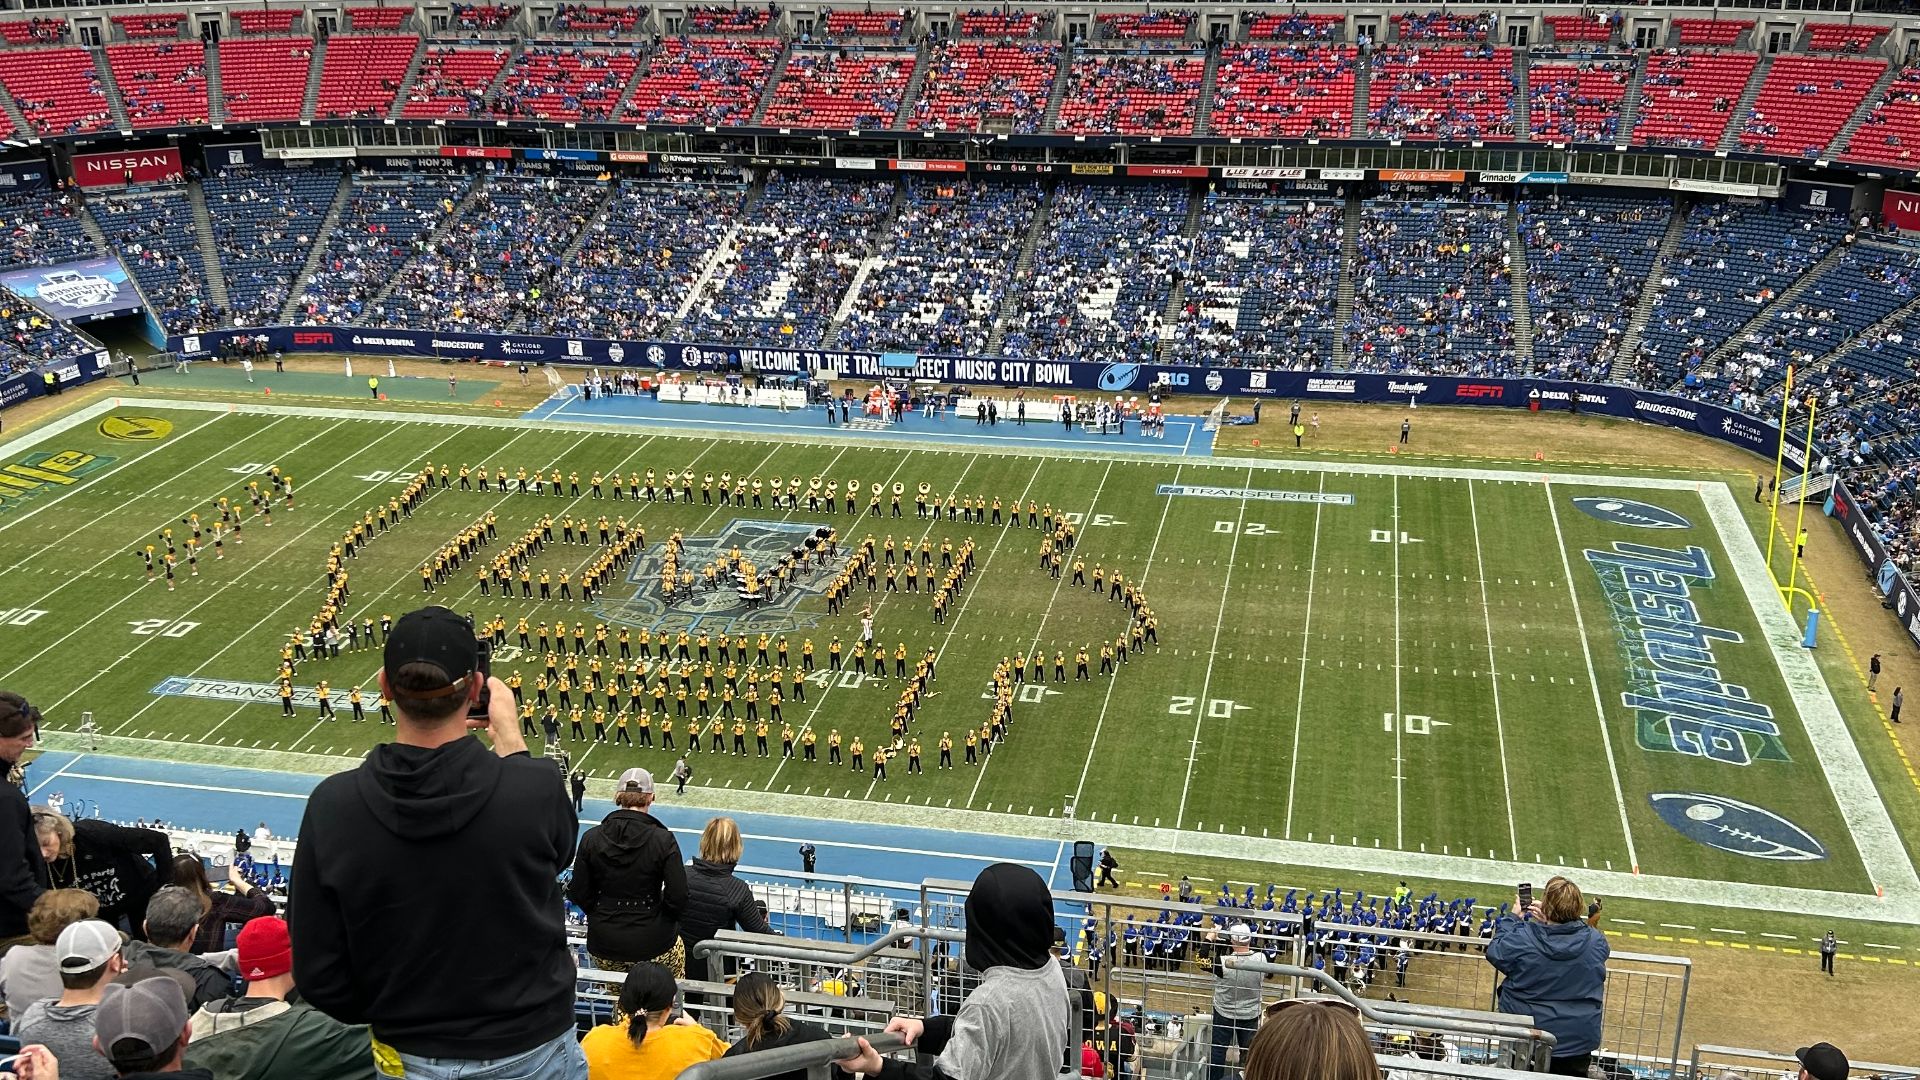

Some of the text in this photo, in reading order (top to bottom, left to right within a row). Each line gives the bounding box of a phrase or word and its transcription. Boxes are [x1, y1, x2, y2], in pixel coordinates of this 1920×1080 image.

[87, 156, 168, 172] NISSAN
[387, 159, 410, 167] RING
[1393, 171, 1418, 180] Tito's
[1481, 173, 1516, 182] Pinnacle
[294, 332, 334, 344] ESPN
[432, 340, 485, 350] BRIDGESTONE
[740, 349, 801, 371] WELCOME
[825, 354, 850, 374] THE
[955, 359, 997, 381] MUSIC
[1001, 361, 1031, 382] CITY
[1035, 363, 1074, 385] BOWL
[1456, 385, 1505, 398] ESPN
[1542, 391, 1607, 404] DELTA ENTAL
[1635, 400, 1698, 421] BRIDGESTONE
[1733, 422, 1762, 436] GAYLORD
[1187, 487, 1348, 503] TRANSPERFECT
[1212, 520, 1266, 536] 20
[1370, 528, 1407, 544] 10
[130, 618, 202, 638] 20
[1582, 541, 1781, 765] Nashville
[804, 668, 871, 688] 40
[195, 683, 383, 707] TRANSERET
[1169, 695, 1238, 719] 20
[1383, 712, 1432, 735] 10
[1161, 882, 1170, 893] 20
